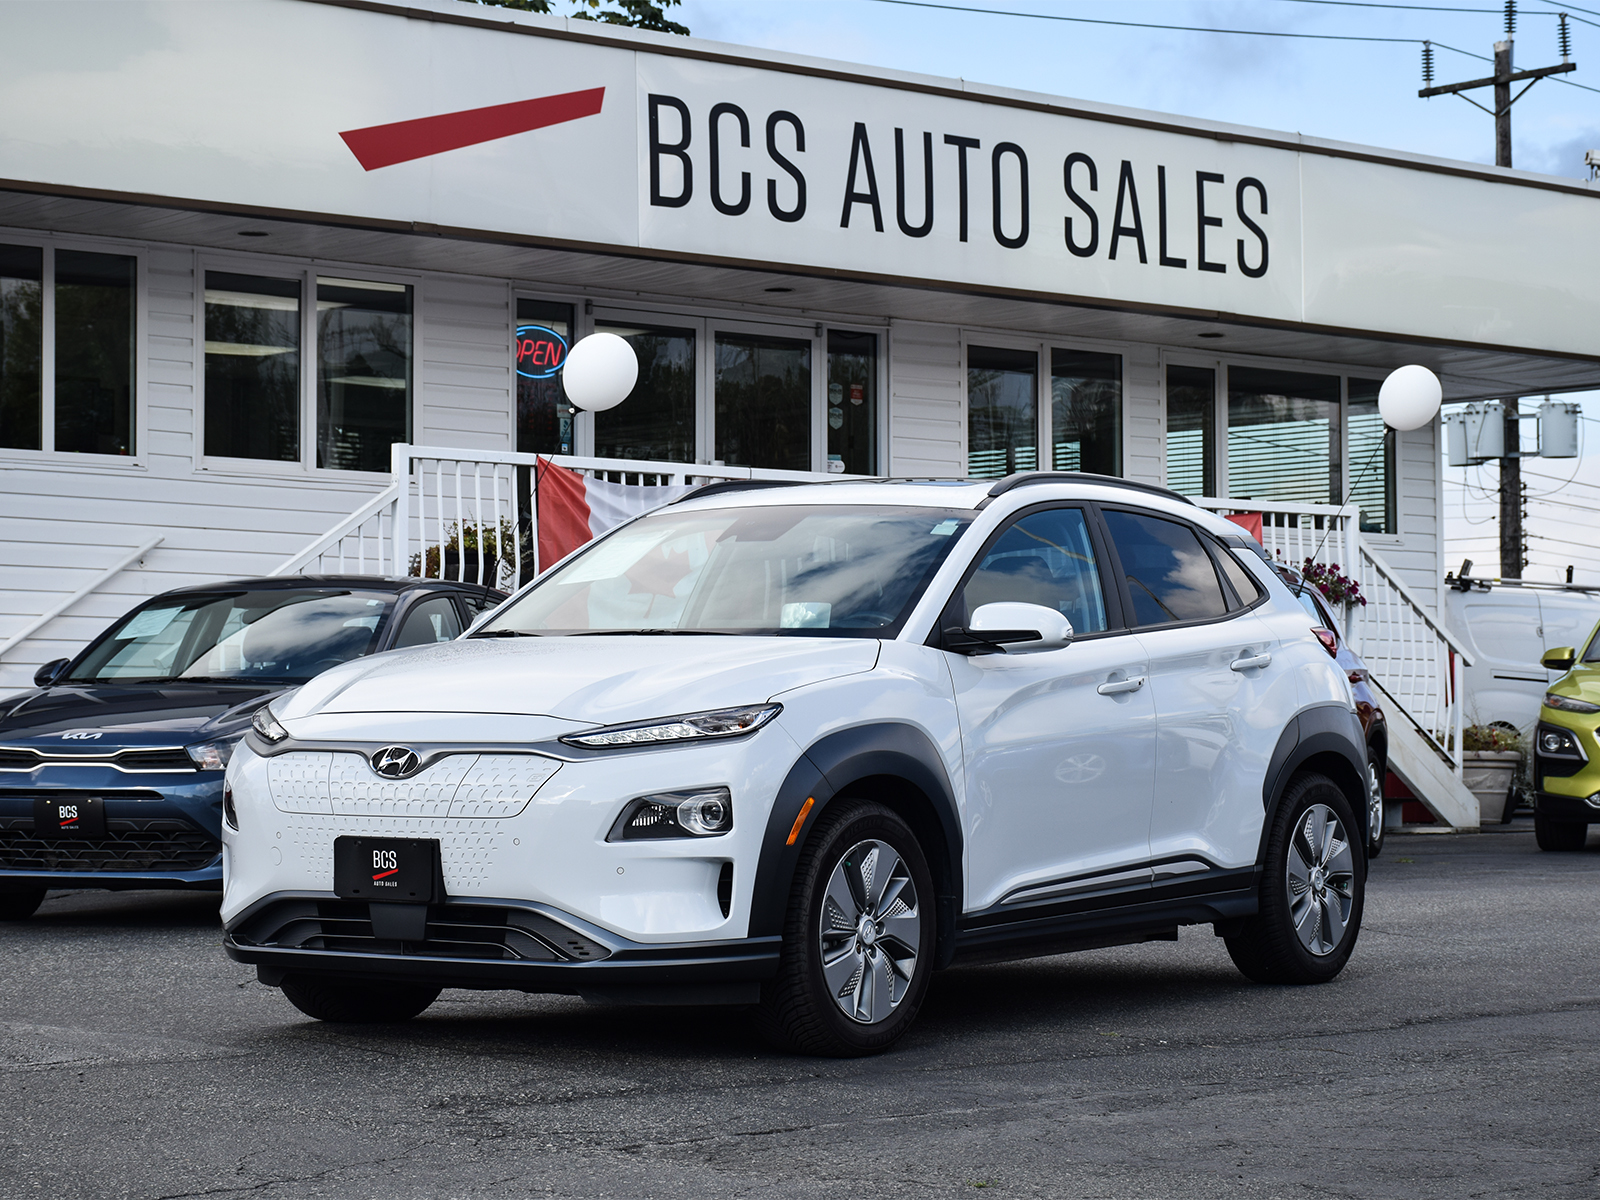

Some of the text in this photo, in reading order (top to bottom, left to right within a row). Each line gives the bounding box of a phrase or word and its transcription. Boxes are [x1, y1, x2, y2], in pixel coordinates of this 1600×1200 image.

[648, 94, 1269, 279] BCS AUTO SALES
[58, 805, 78, 819] BCS
[372, 850, 397, 869] BCS
[373, 880, 384, 888] AUTO
